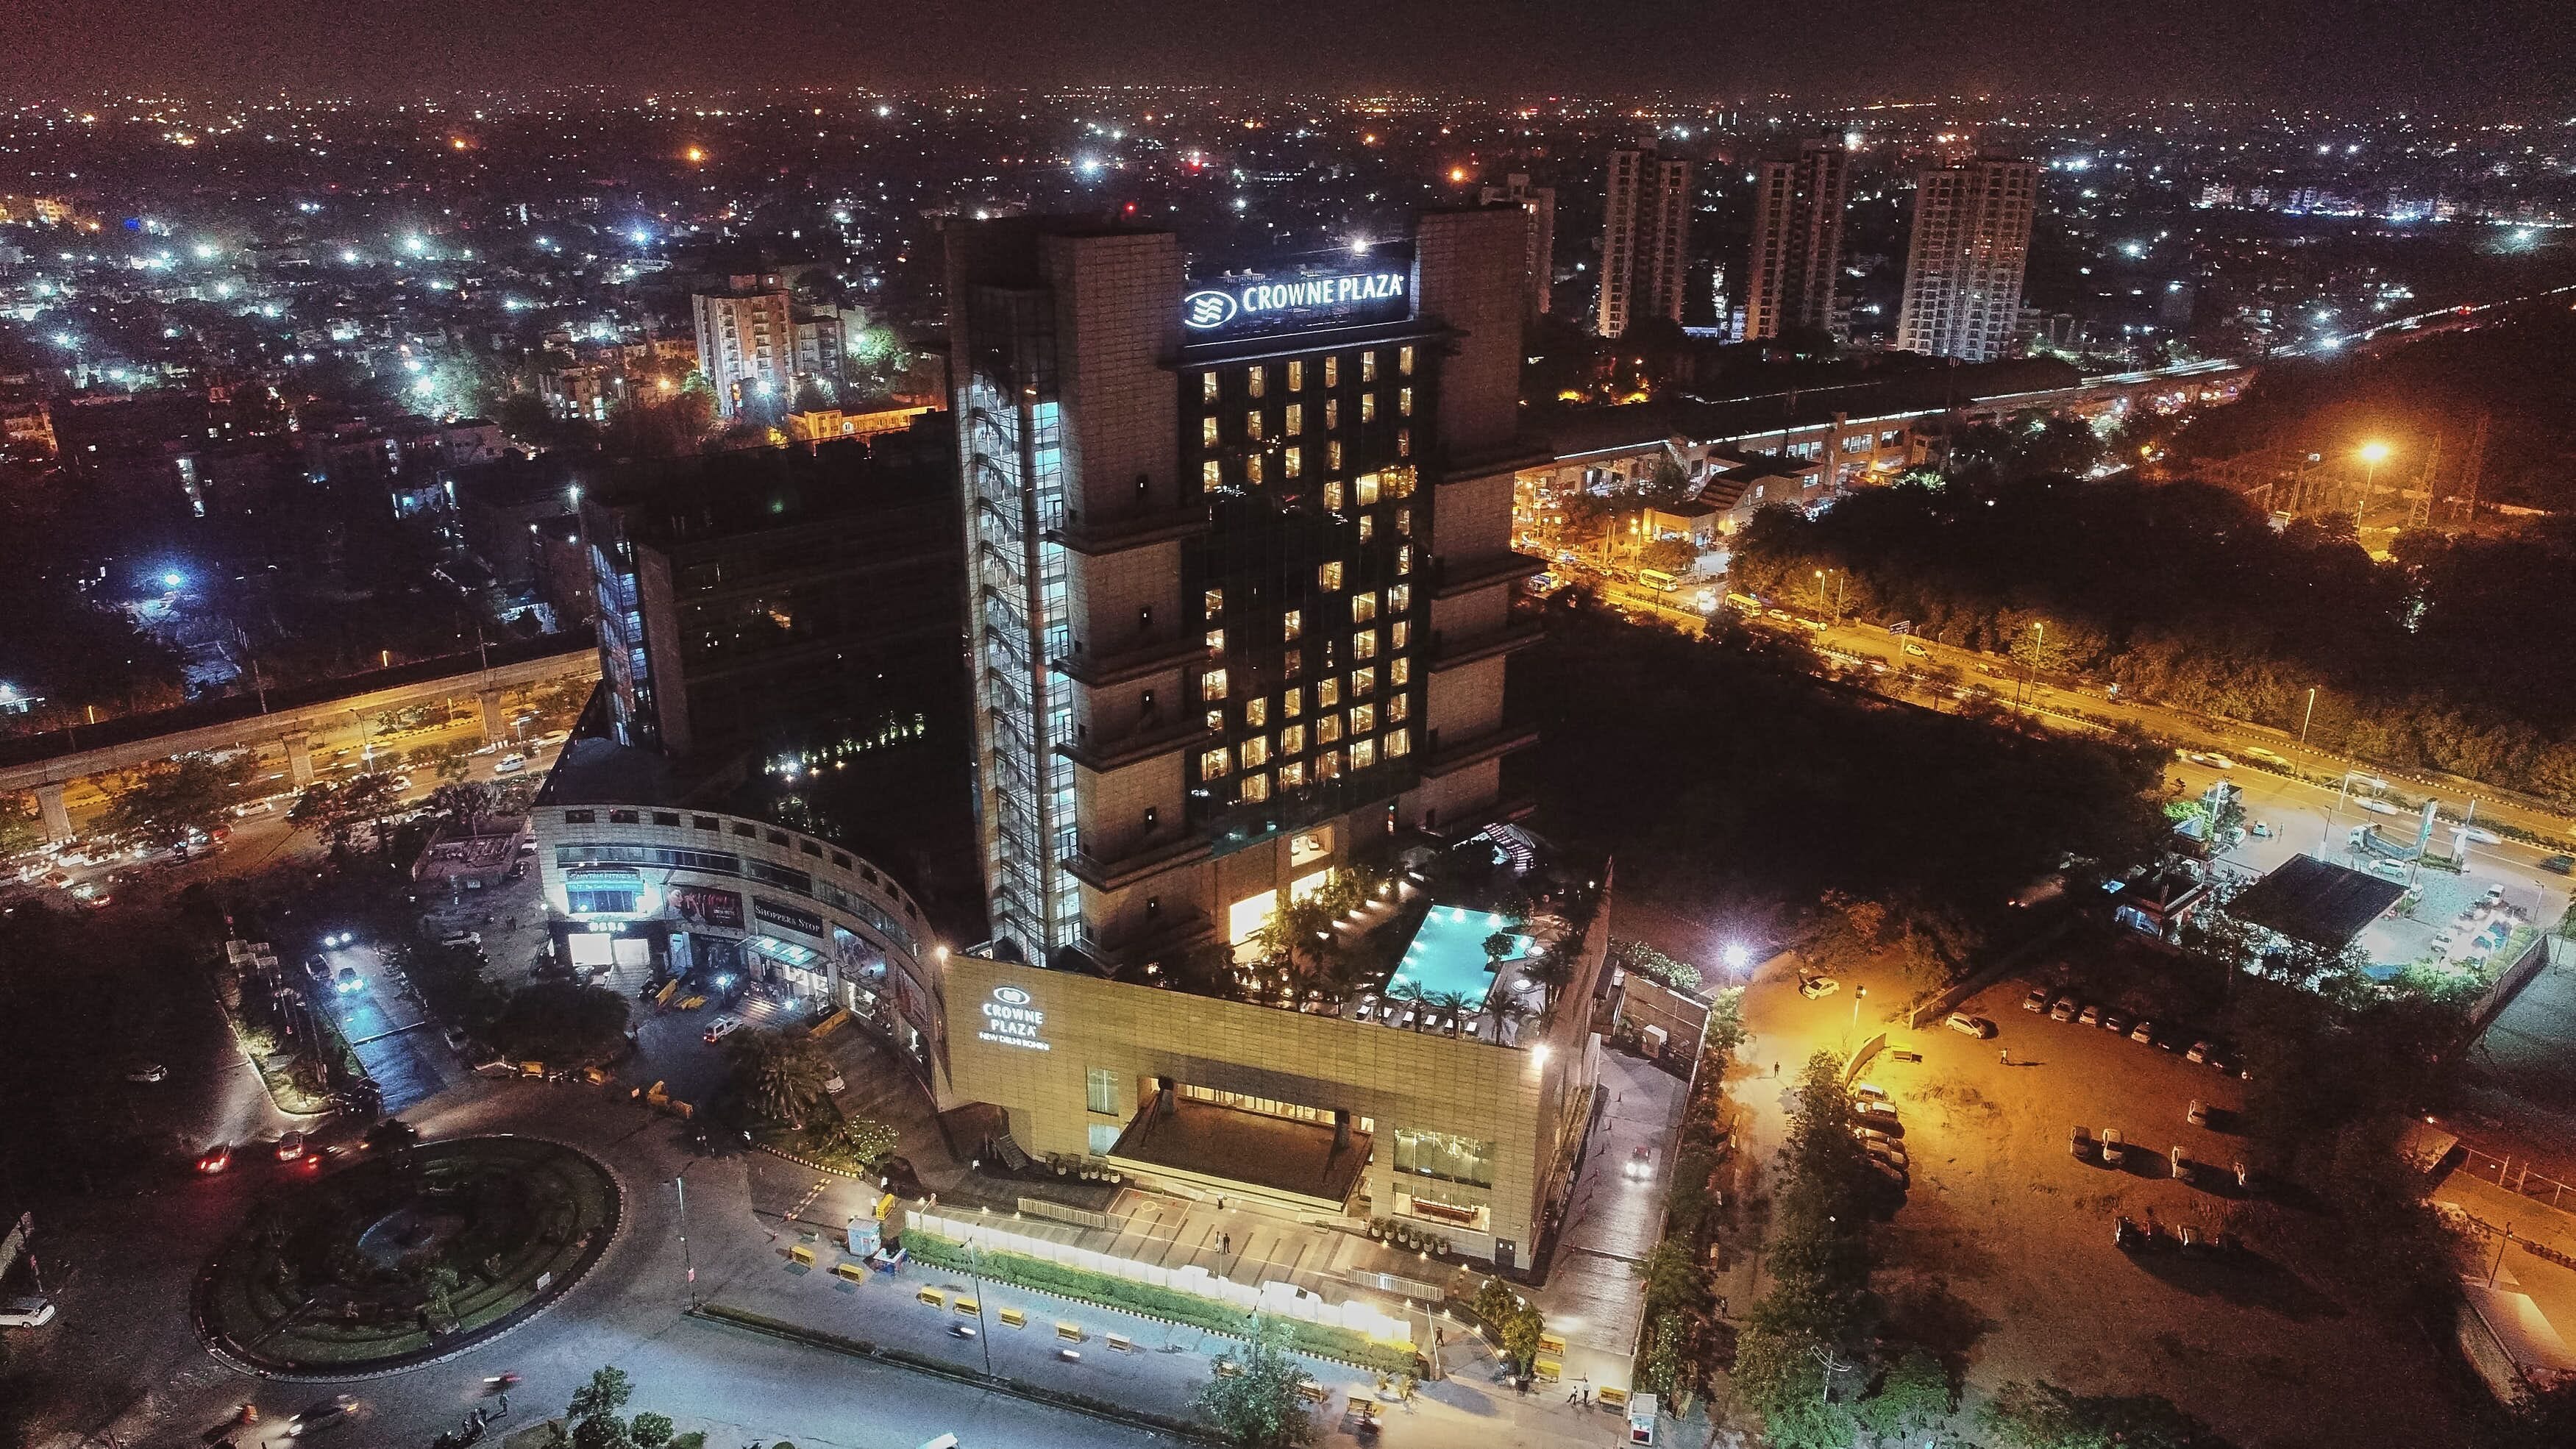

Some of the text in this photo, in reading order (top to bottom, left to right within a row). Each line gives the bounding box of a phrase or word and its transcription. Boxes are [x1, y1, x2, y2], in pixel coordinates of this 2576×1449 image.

[1243, 274, 1403, 312] CROWNE PLAZA
[798, 918, 820, 932] STOP
[983, 1003, 1044, 1025] CROWNE
[991, 1019, 1036, 1037] PLAZA
[978, 1031, 998, 1042] NEW
[999, 1035, 1022, 1045] DELHI
